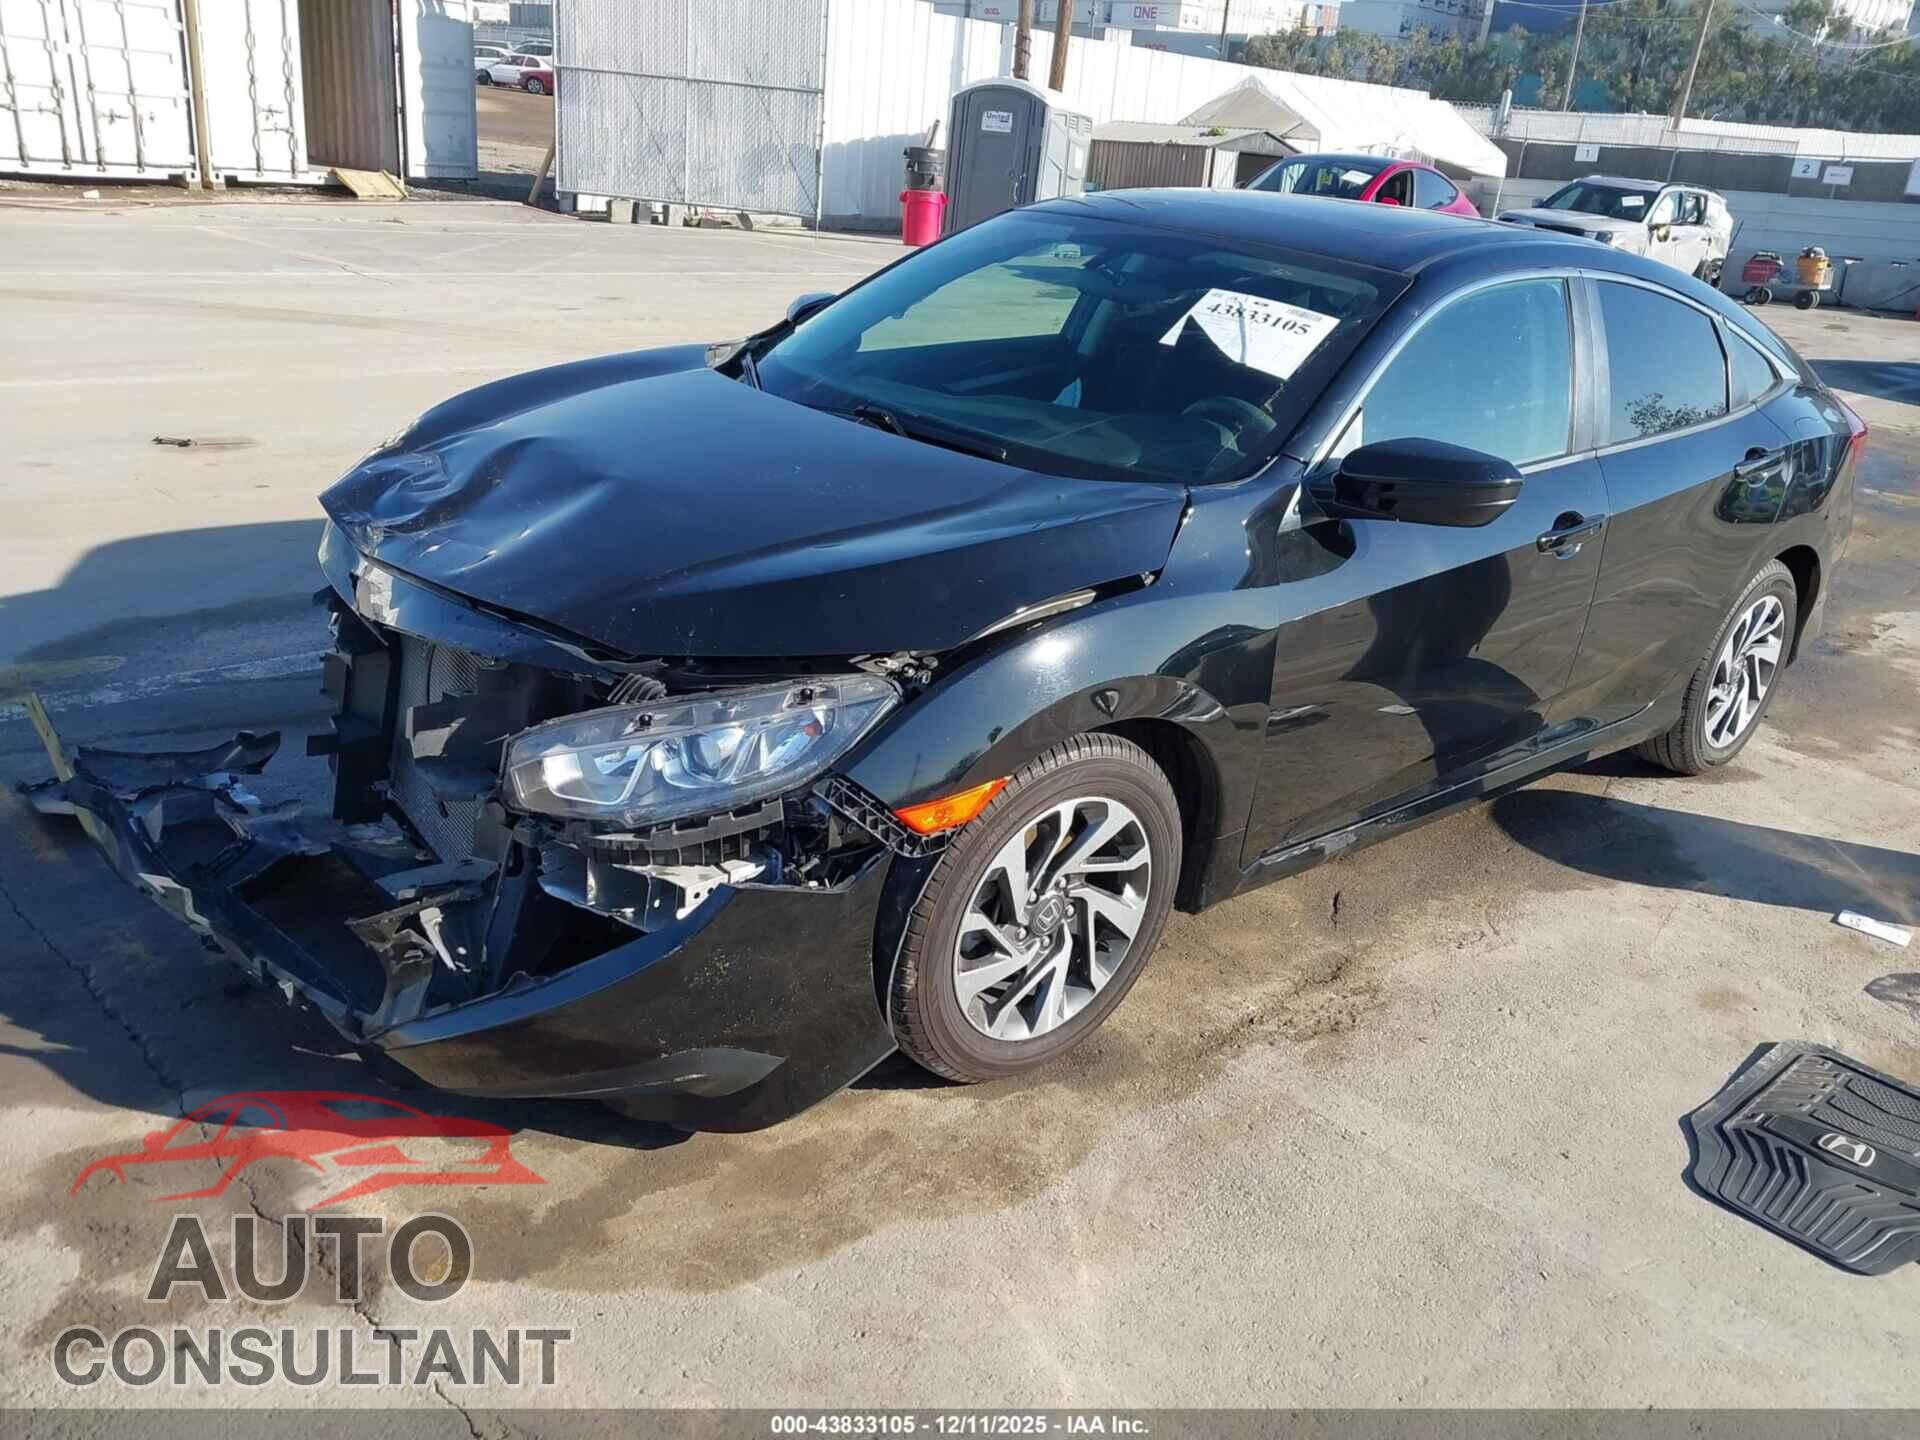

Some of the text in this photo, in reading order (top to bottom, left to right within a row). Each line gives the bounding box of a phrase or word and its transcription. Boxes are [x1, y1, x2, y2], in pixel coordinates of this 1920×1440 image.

[1134, 6, 1158, 19] ONE
[1800, 163, 1811, 175] 2
[1206, 302, 1312, 335] 43833105
